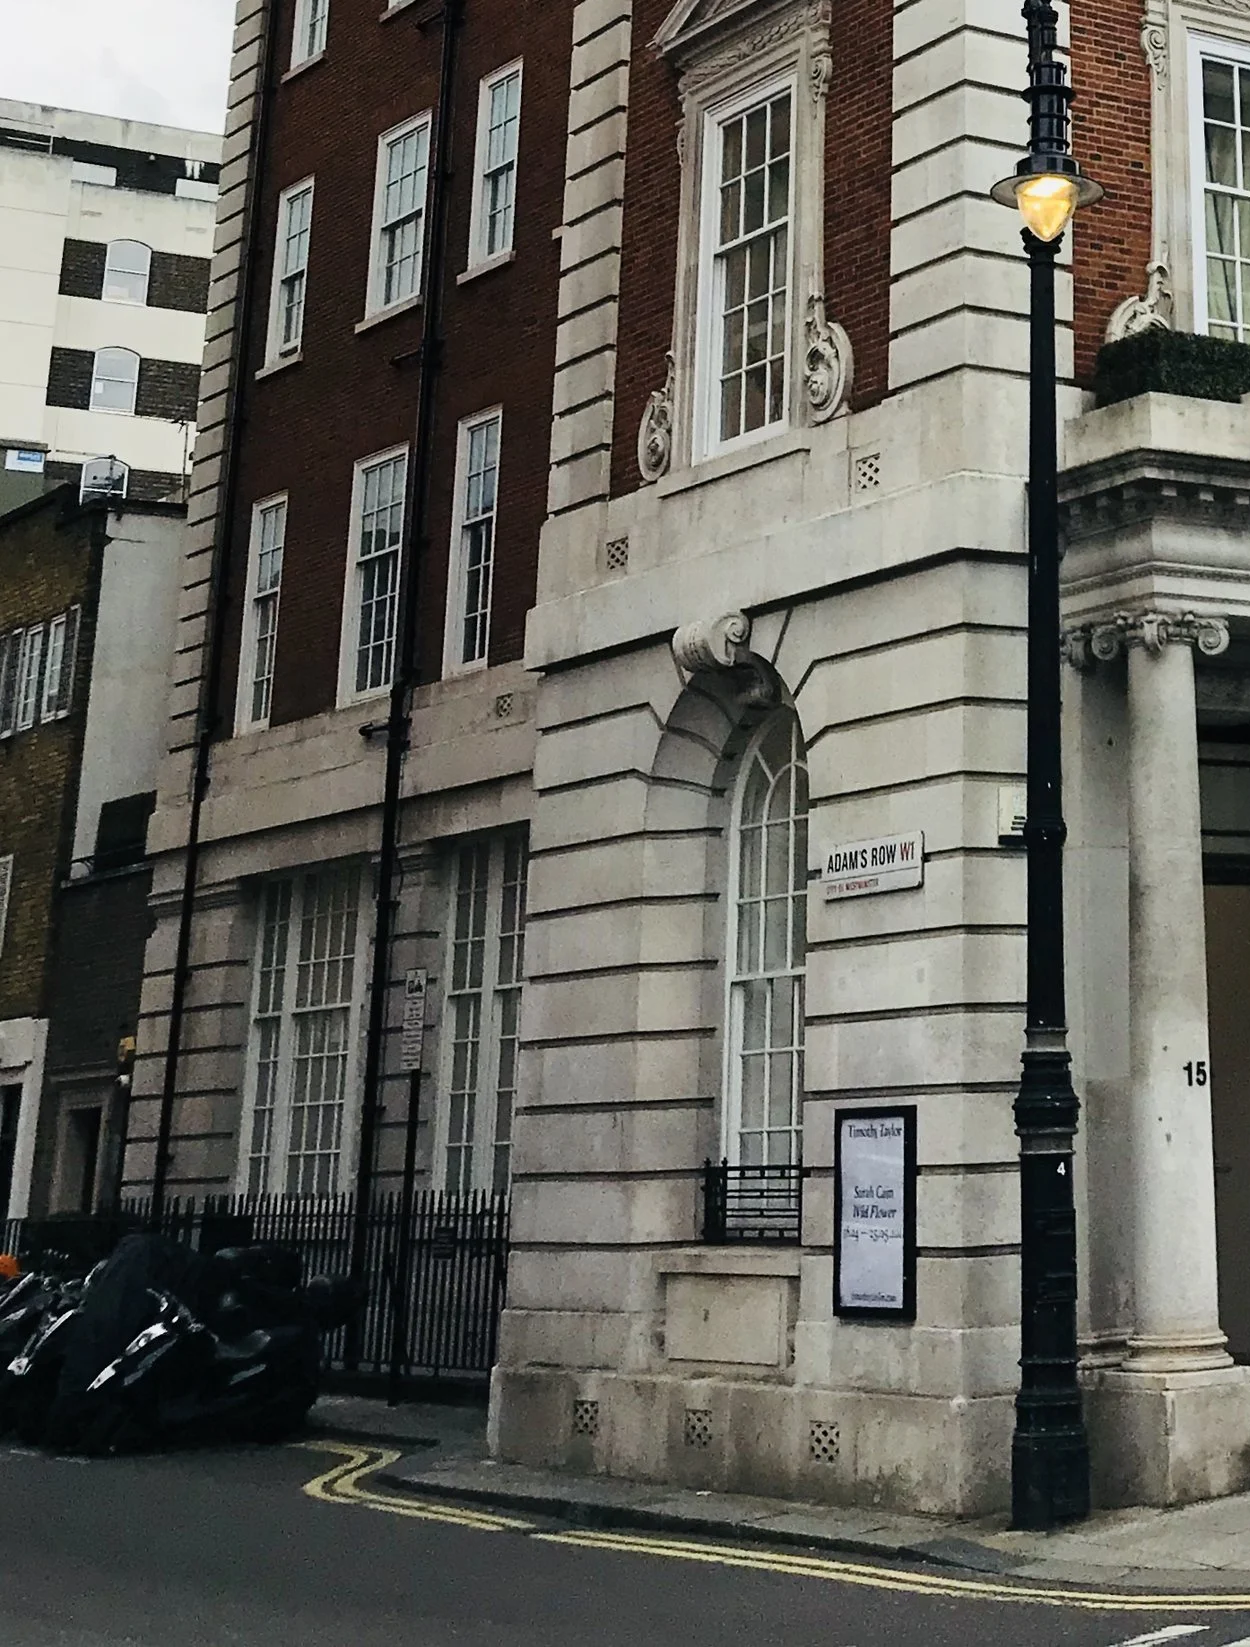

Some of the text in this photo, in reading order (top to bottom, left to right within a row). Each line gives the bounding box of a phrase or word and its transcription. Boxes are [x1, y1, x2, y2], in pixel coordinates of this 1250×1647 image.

[827, 840, 915, 874] ADAM'S ROW W1
[1182, 1060, 1207, 1087] 15
[1056, 1161, 1066, 1176] 4
